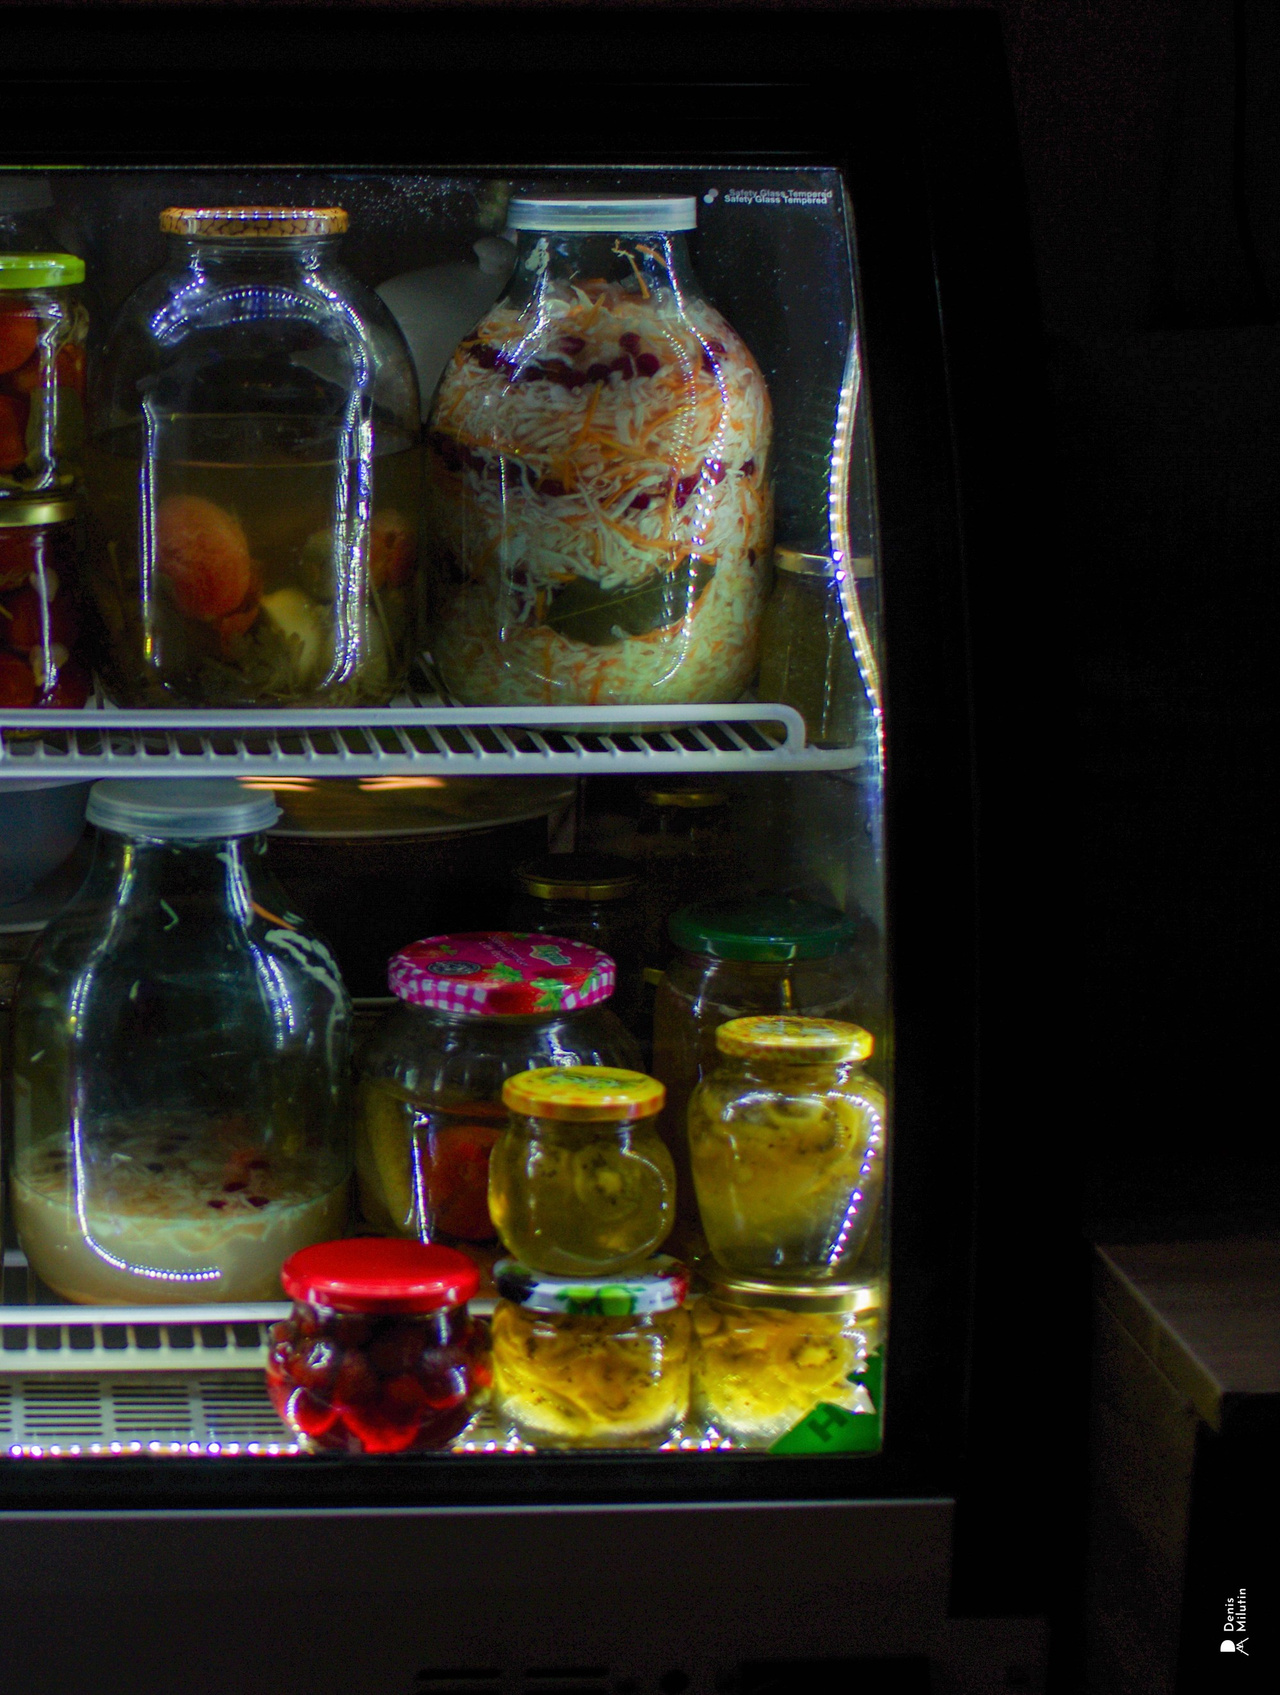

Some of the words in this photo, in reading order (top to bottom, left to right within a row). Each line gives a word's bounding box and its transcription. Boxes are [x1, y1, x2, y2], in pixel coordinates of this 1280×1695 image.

[724, 194, 753, 204] Safety
[754, 195, 781, 204] Glass
[783, 195, 828, 205] Tempered
